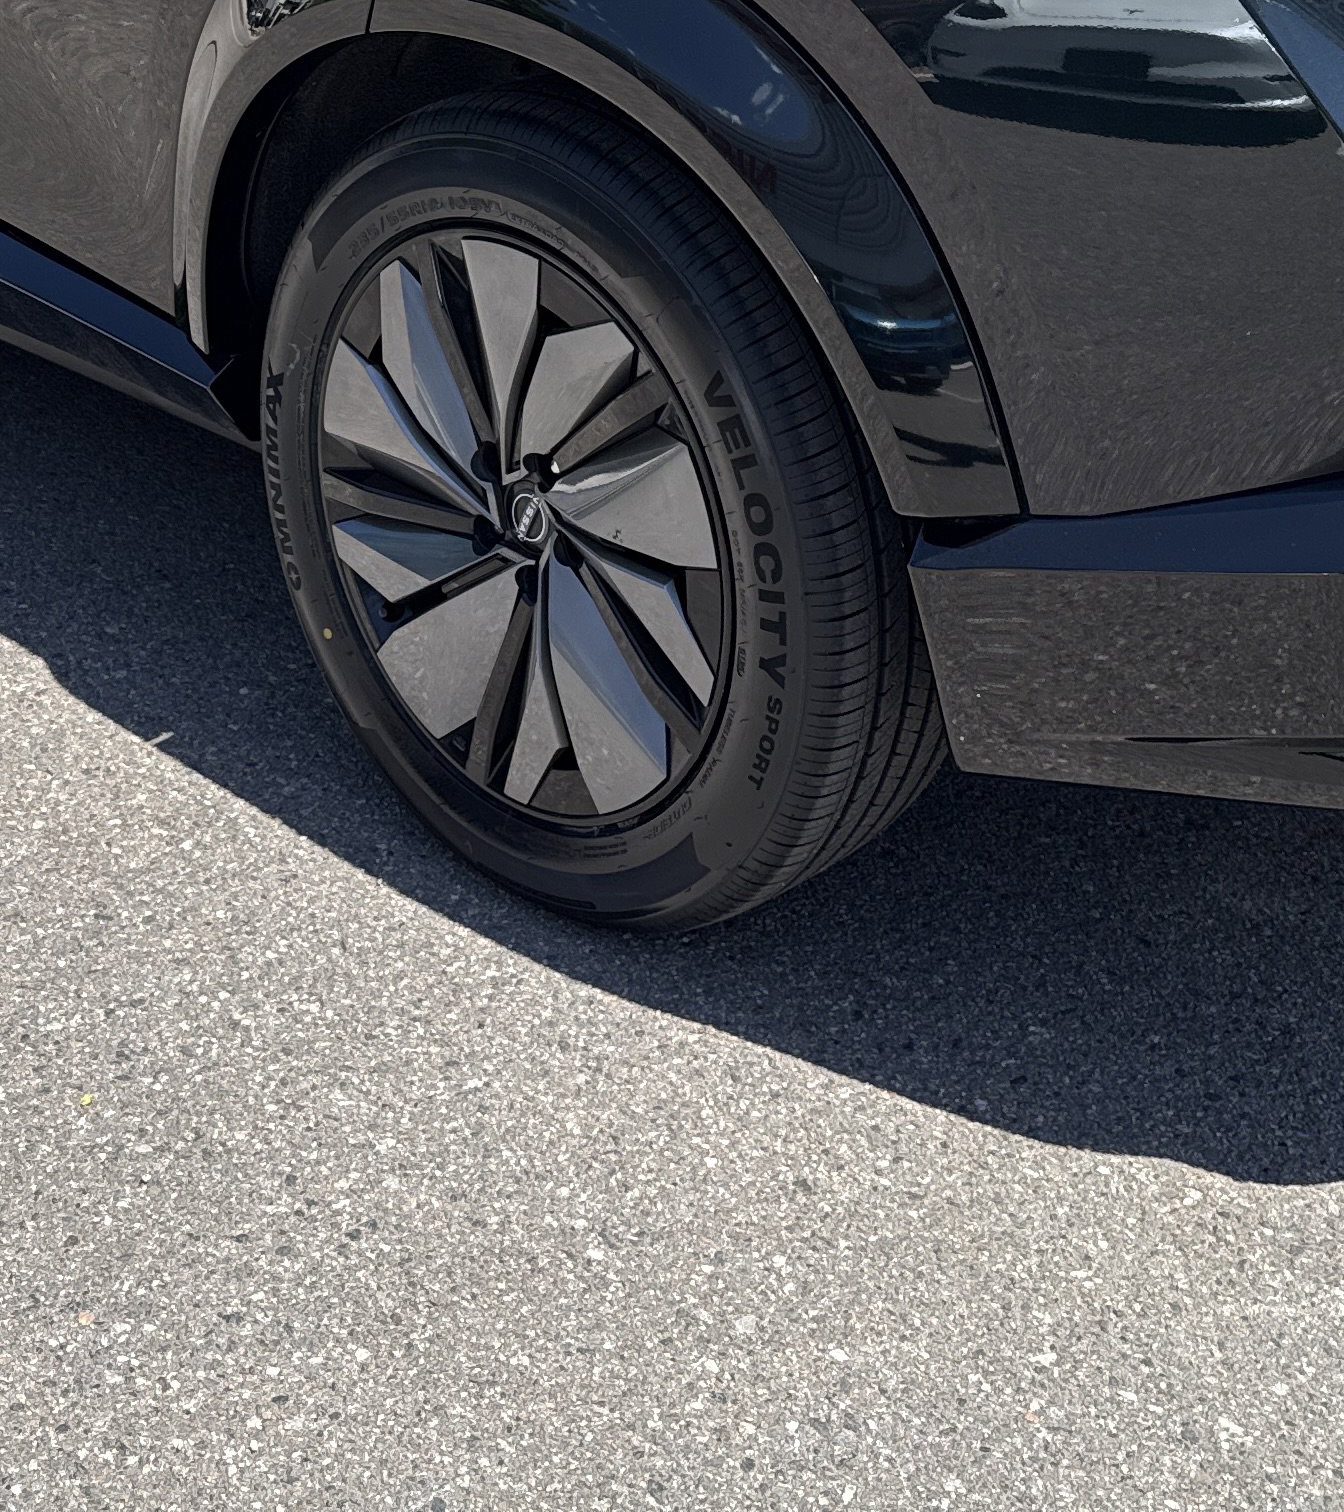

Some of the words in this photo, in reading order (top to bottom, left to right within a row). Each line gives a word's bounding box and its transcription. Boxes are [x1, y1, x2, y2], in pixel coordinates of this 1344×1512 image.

[264, 354, 302, 591] OMNIMAX
[703, 370, 788, 691] VELOCITY
[747, 695, 784, 791] SPORT
